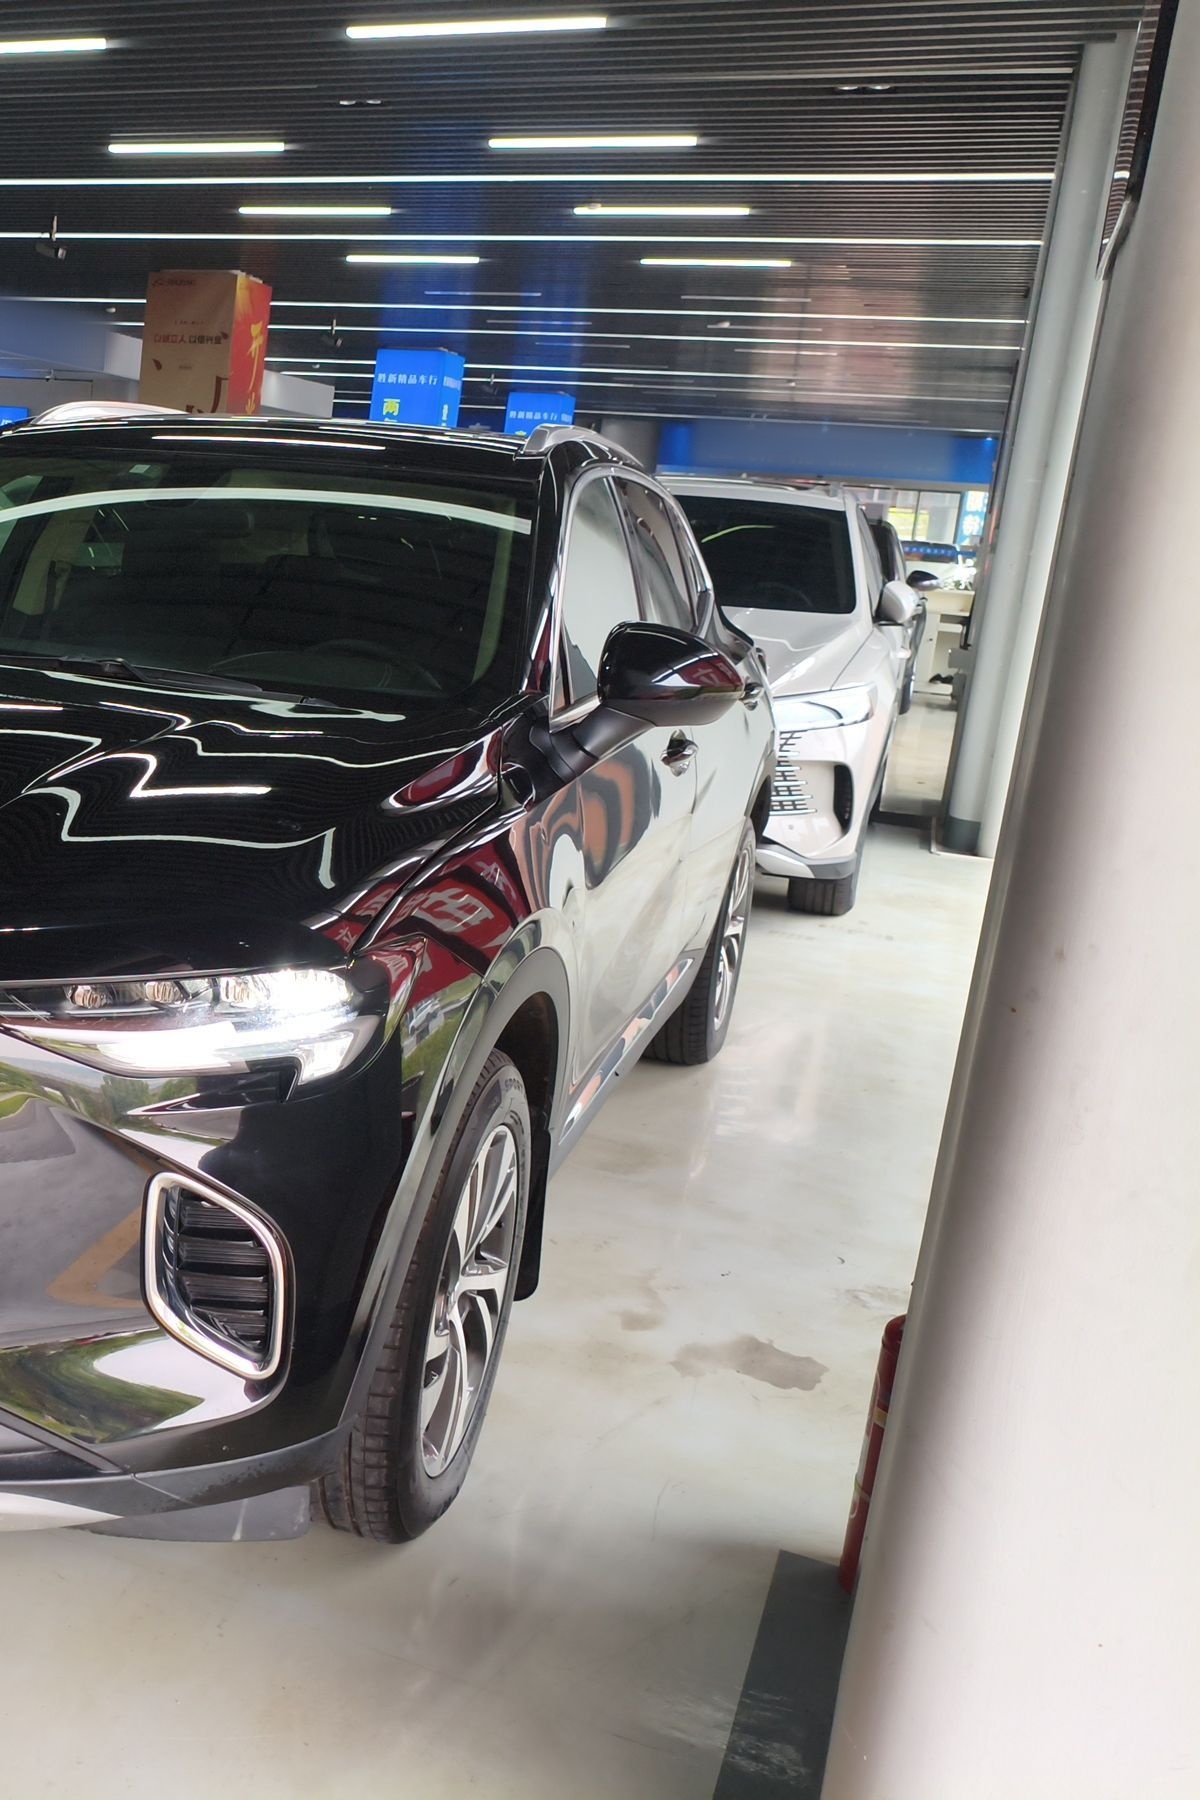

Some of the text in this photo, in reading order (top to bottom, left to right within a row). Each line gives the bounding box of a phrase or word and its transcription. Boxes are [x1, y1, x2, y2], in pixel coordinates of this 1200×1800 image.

[377, 373, 438, 386] 胜新精品车行
